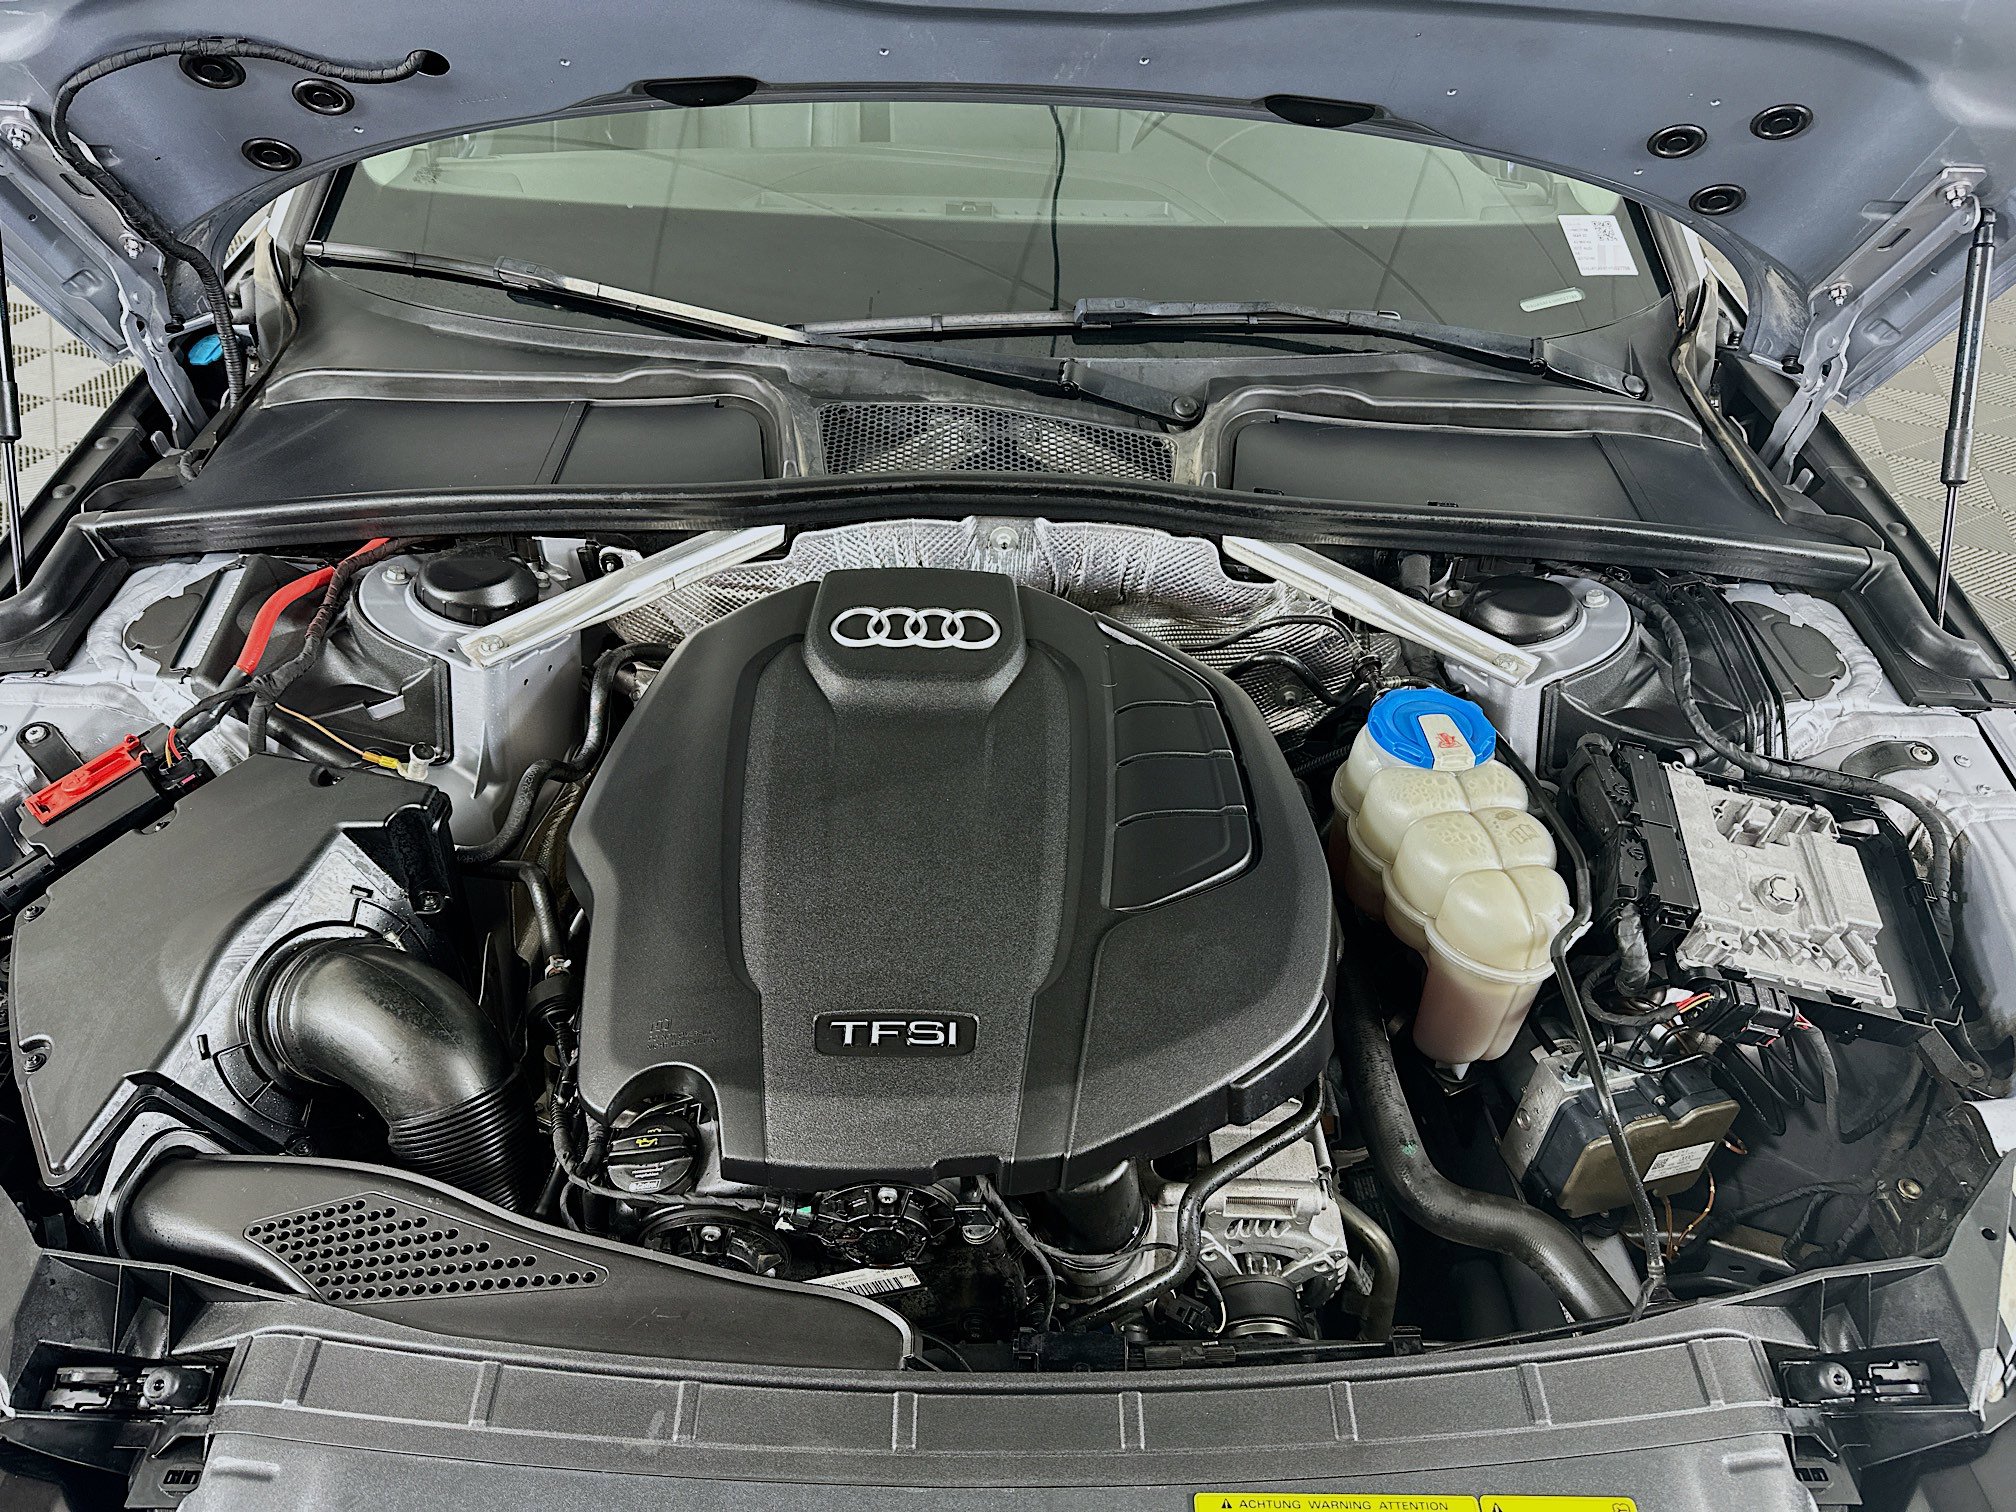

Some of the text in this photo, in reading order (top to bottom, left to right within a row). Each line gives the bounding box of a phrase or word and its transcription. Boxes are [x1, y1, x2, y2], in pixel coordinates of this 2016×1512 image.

[829, 1020, 957, 1048] TFSI
[1239, 1499, 1449, 1511] ACHTUNG WARNING ATTENTION
